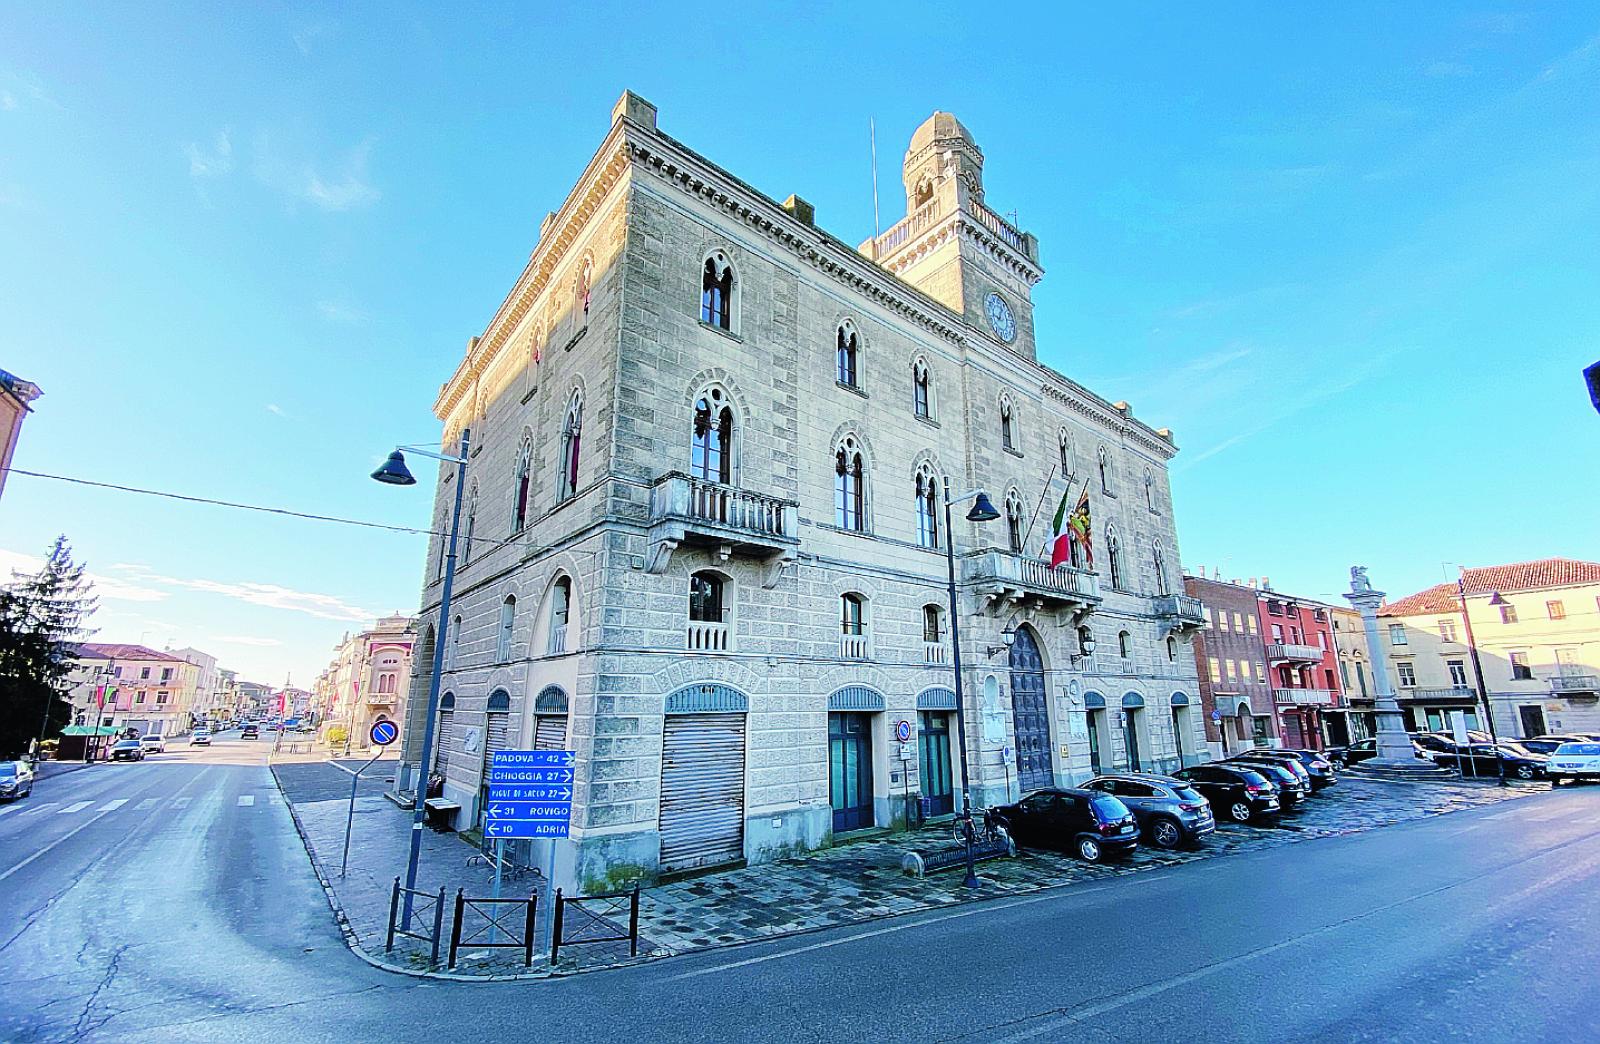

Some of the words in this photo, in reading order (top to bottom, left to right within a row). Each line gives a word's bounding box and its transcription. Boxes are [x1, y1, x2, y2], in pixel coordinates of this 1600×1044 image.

[495, 755, 534, 763] PADOVA
[546, 755, 559, 763] 42
[494, 772, 543, 780] CHIOGGIA
[546, 772, 559, 780] 27
[504, 807, 515, 815] 31
[529, 807, 568, 816] ROVIGO
[503, 825, 513, 833] 10
[535, 825, 567, 834] ADRIA
